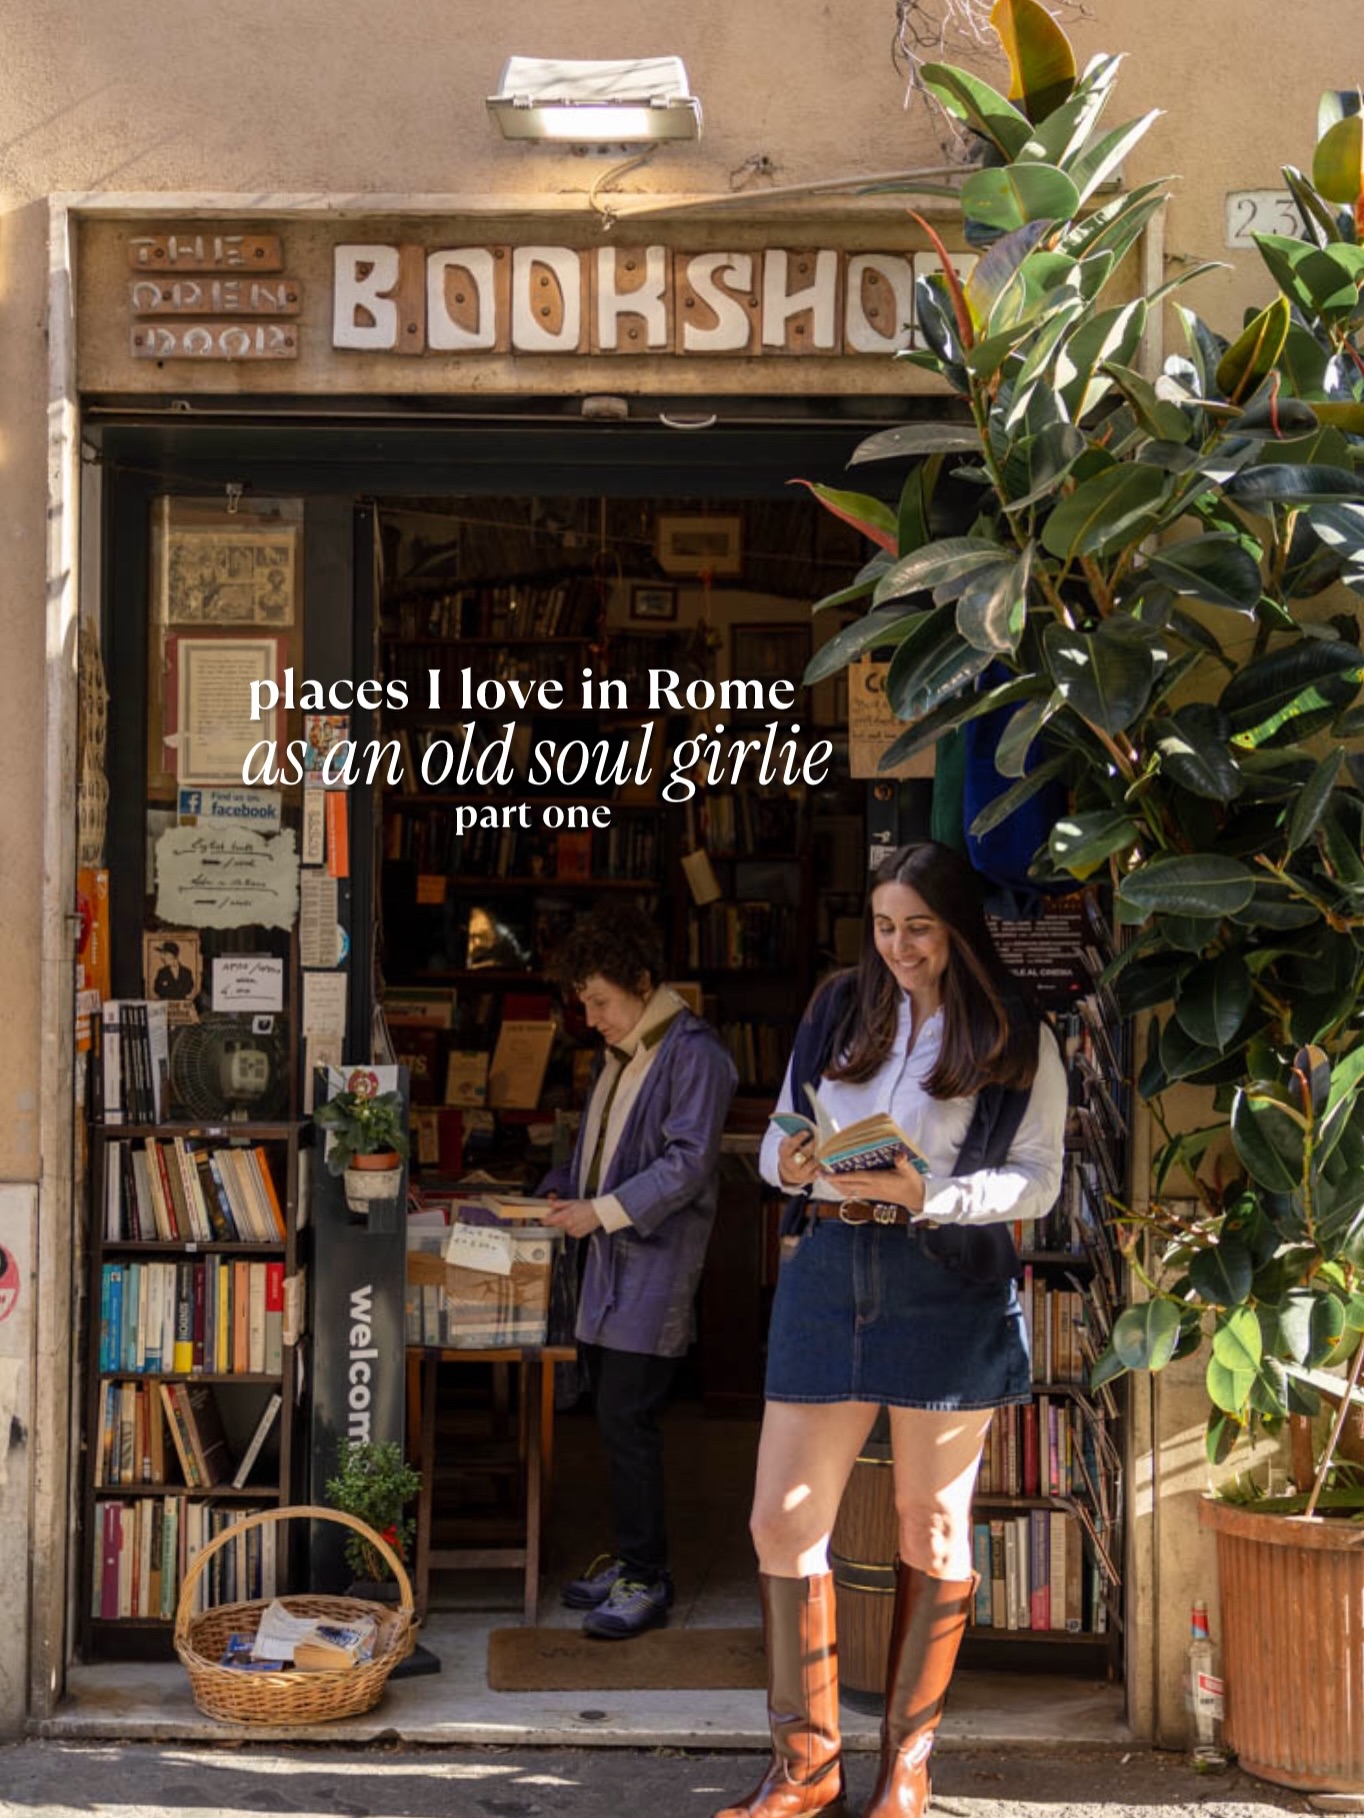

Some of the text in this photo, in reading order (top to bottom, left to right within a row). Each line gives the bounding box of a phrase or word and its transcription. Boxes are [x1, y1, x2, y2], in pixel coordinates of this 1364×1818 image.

[1235, 199, 1298, 237] 23
[129, 235, 246, 264] THE
[133, 281, 287, 311] OPEN
[146, 326, 287, 357] DOOR
[211, 801, 277, 818] facebook
[348, 1285, 378, 1472] welcom
